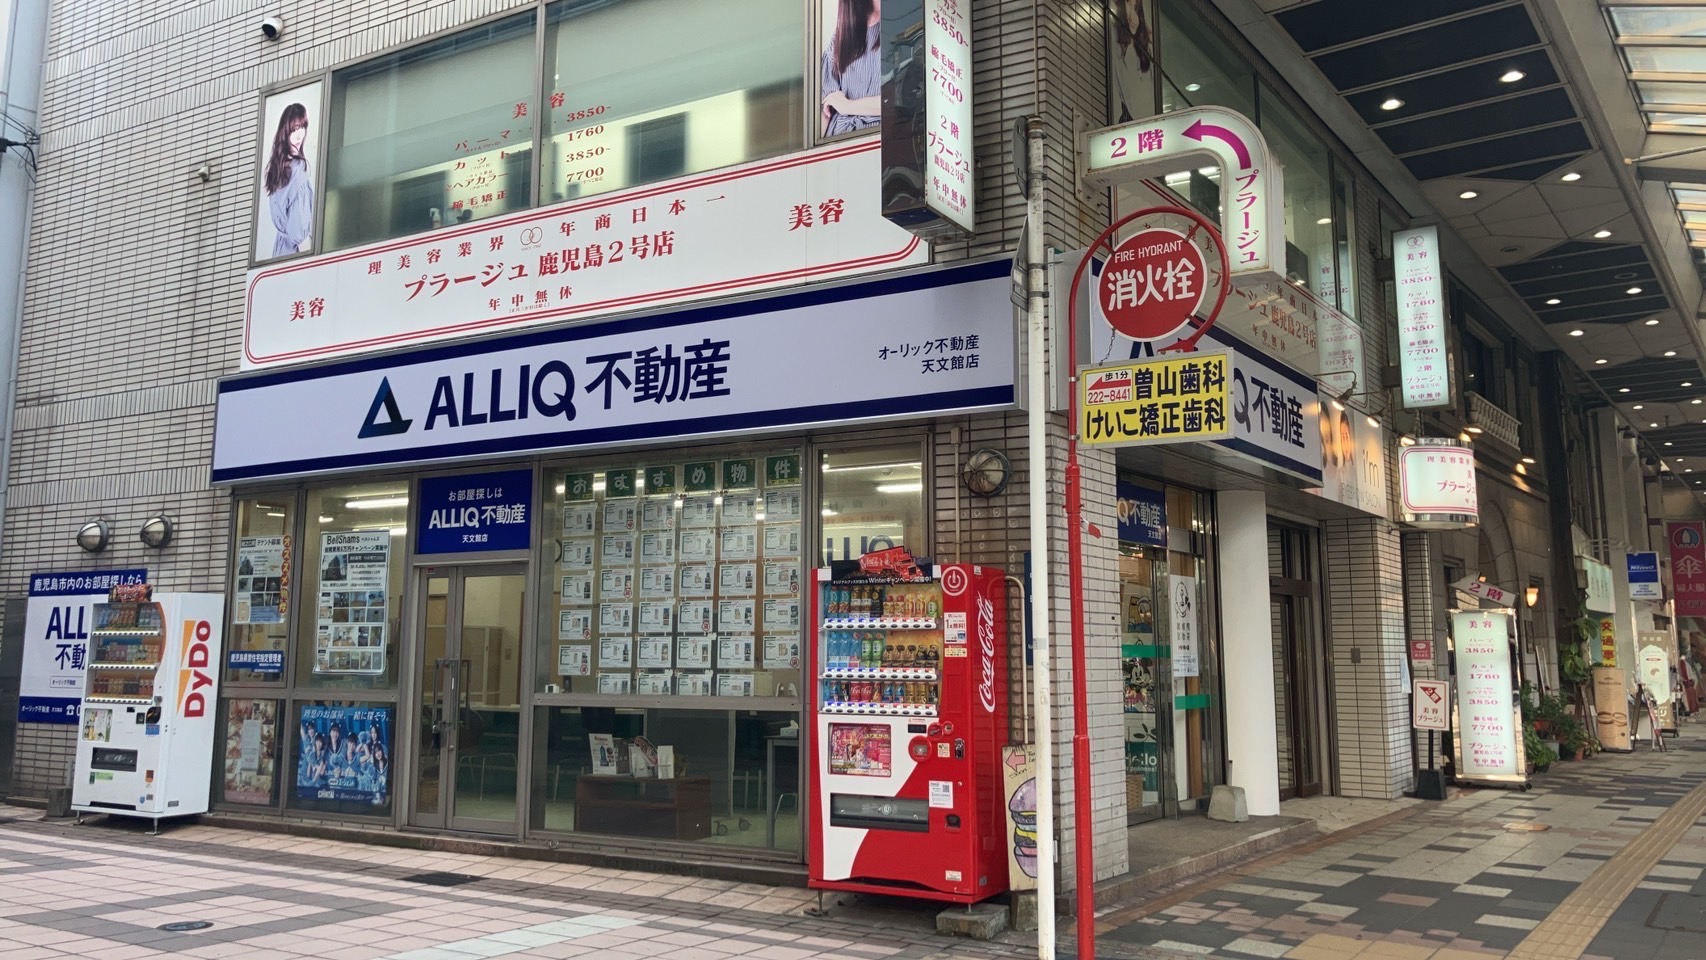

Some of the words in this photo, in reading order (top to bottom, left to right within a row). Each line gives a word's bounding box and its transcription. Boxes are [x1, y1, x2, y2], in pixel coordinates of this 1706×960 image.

[932, 68, 963, 102] 7700
[512, 92, 565, 119] 美容
[568, 125, 604, 142] 1760
[941, 115, 959, 140] 2階
[455, 130, 511, 151] パーマ
[928, 131, 970, 173] プラージュ
[1110, 128, 1164, 159] 2階
[454, 150, 511, 171] カット
[567, 167, 604, 183] 7700
[452, 190, 508, 209] 縮毛矯正
[933, 176, 967, 209] 年中無休
[788, 198, 846, 231] 美容
[1235, 168, 1261, 264] プラージュ
[367, 234, 505, 276] 理美容業界
[559, 195, 726, 237] 年商日本一
[1114, 249, 1135, 264] FIRE
[1138, 240, 1183, 259] HYDRANT
[405, 262, 529, 302] プラージュ
[538, 230, 675, 278] 鹿児島2号店
[1107, 257, 1196, 311] 消火栓
[289, 297, 326, 322] 美容
[488, 286, 573, 311] 年中無休
[1406, 299, 1436, 308] 1760
[1271, 304, 1317, 350] 鹿児島2号店
[878, 334, 980, 360] オーリック不動産
[1407, 347, 1439, 356] 7700
[921, 354, 980, 375] 天文館店
[1105, 371, 1129, 381] 歩1分
[1135, 360, 1225, 400] 曽山歯科
[1088, 388, 1131, 404] 222-8441
[1087, 397, 1226, 440] けいこ矯正歯科
[572, 460, 791, 494] おすすめ物件
[448, 487, 503, 501] お部屋探しは
[327, 535, 360, 545] BellShams
[462, 533, 489, 543] 天文館店
[34, 573, 143, 592] 鹿児島市内のお部屋探しなら
[1468, 582, 1504, 601] 2階
[1468, 619, 1493, 629] 美容
[1601, 620, 1615, 667] 交通事
[1417, 715, 1443, 723] プラージュ
[1423, 707, 1439, 715] 美容
